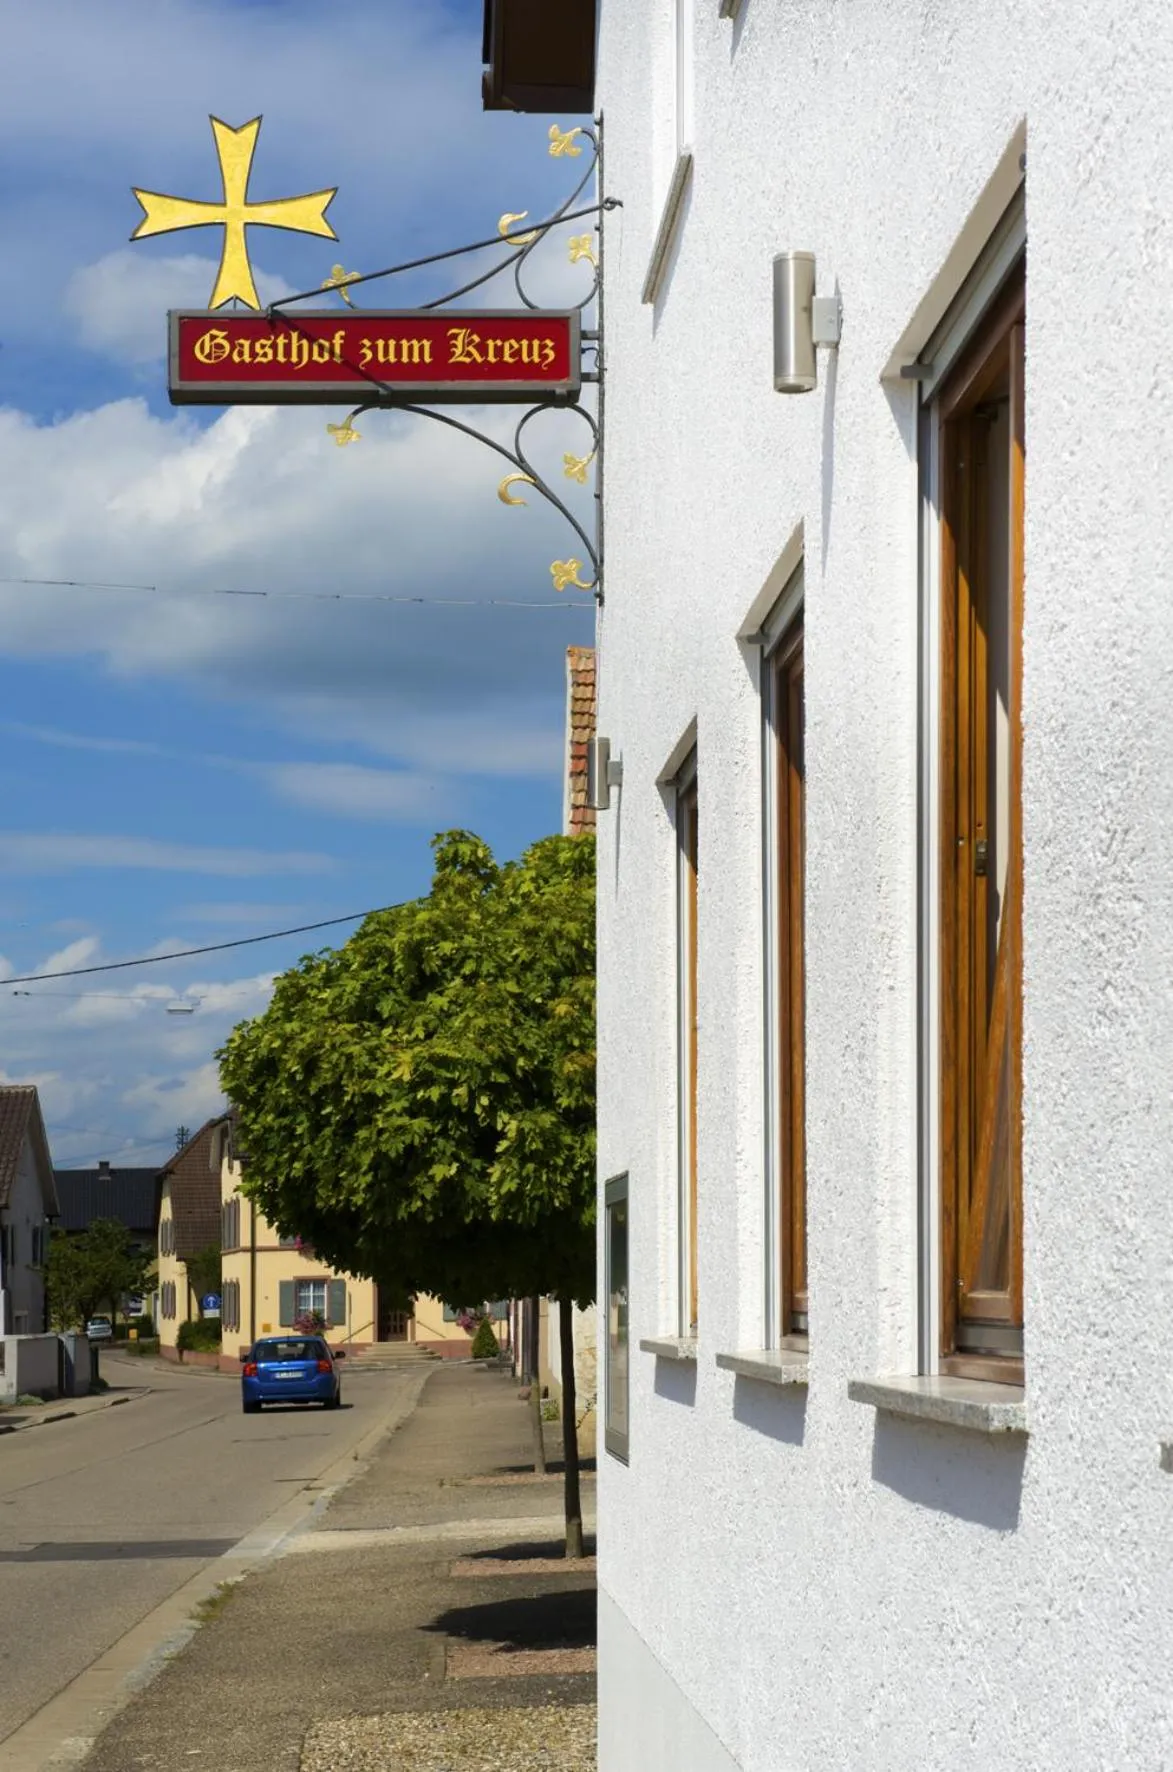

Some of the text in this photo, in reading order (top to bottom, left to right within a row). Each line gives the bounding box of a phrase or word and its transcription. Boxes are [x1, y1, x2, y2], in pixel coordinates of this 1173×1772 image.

[193, 328, 556, 370] Gasthof zum Kreuz
